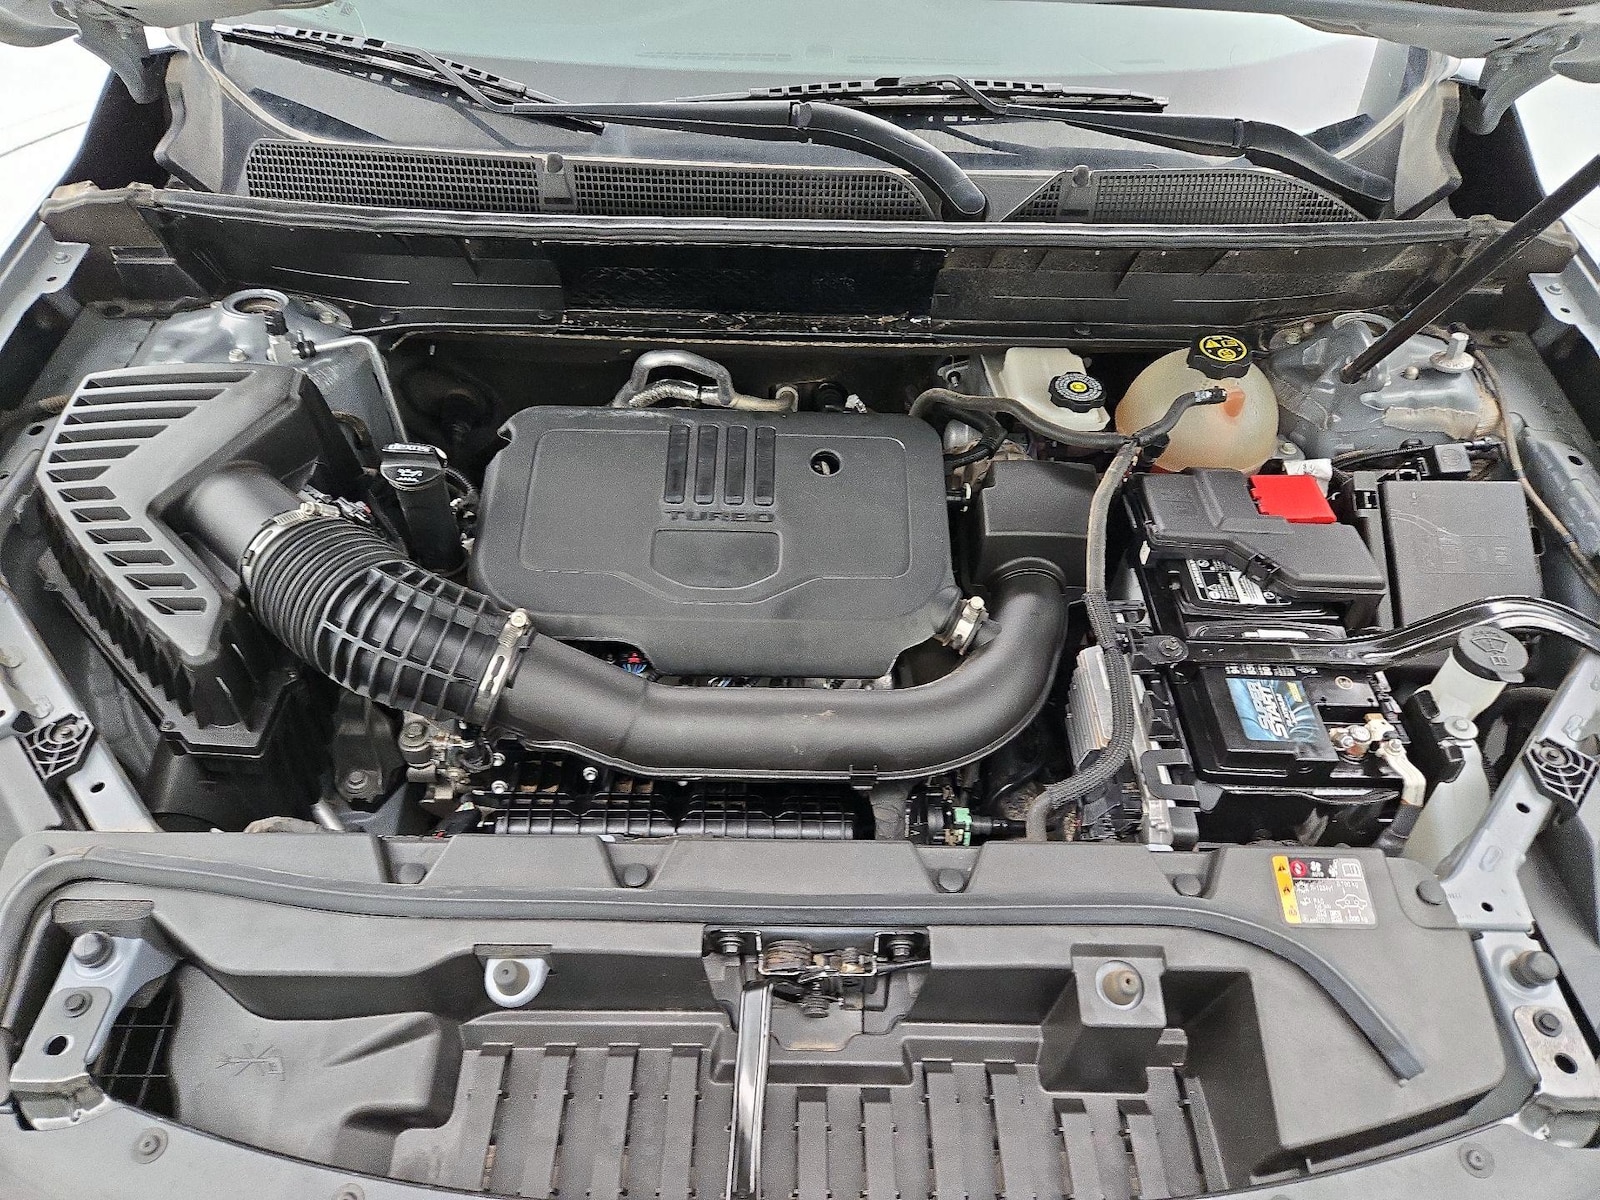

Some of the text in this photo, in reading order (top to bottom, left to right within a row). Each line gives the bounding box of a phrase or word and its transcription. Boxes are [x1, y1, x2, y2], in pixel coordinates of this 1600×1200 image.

[663, 510, 776, 522] TURBO
[1246, 681, 1269, 730] SUPER
[1260, 686, 1290, 739] START
[1275, 693, 1295, 728] PLATINUM
